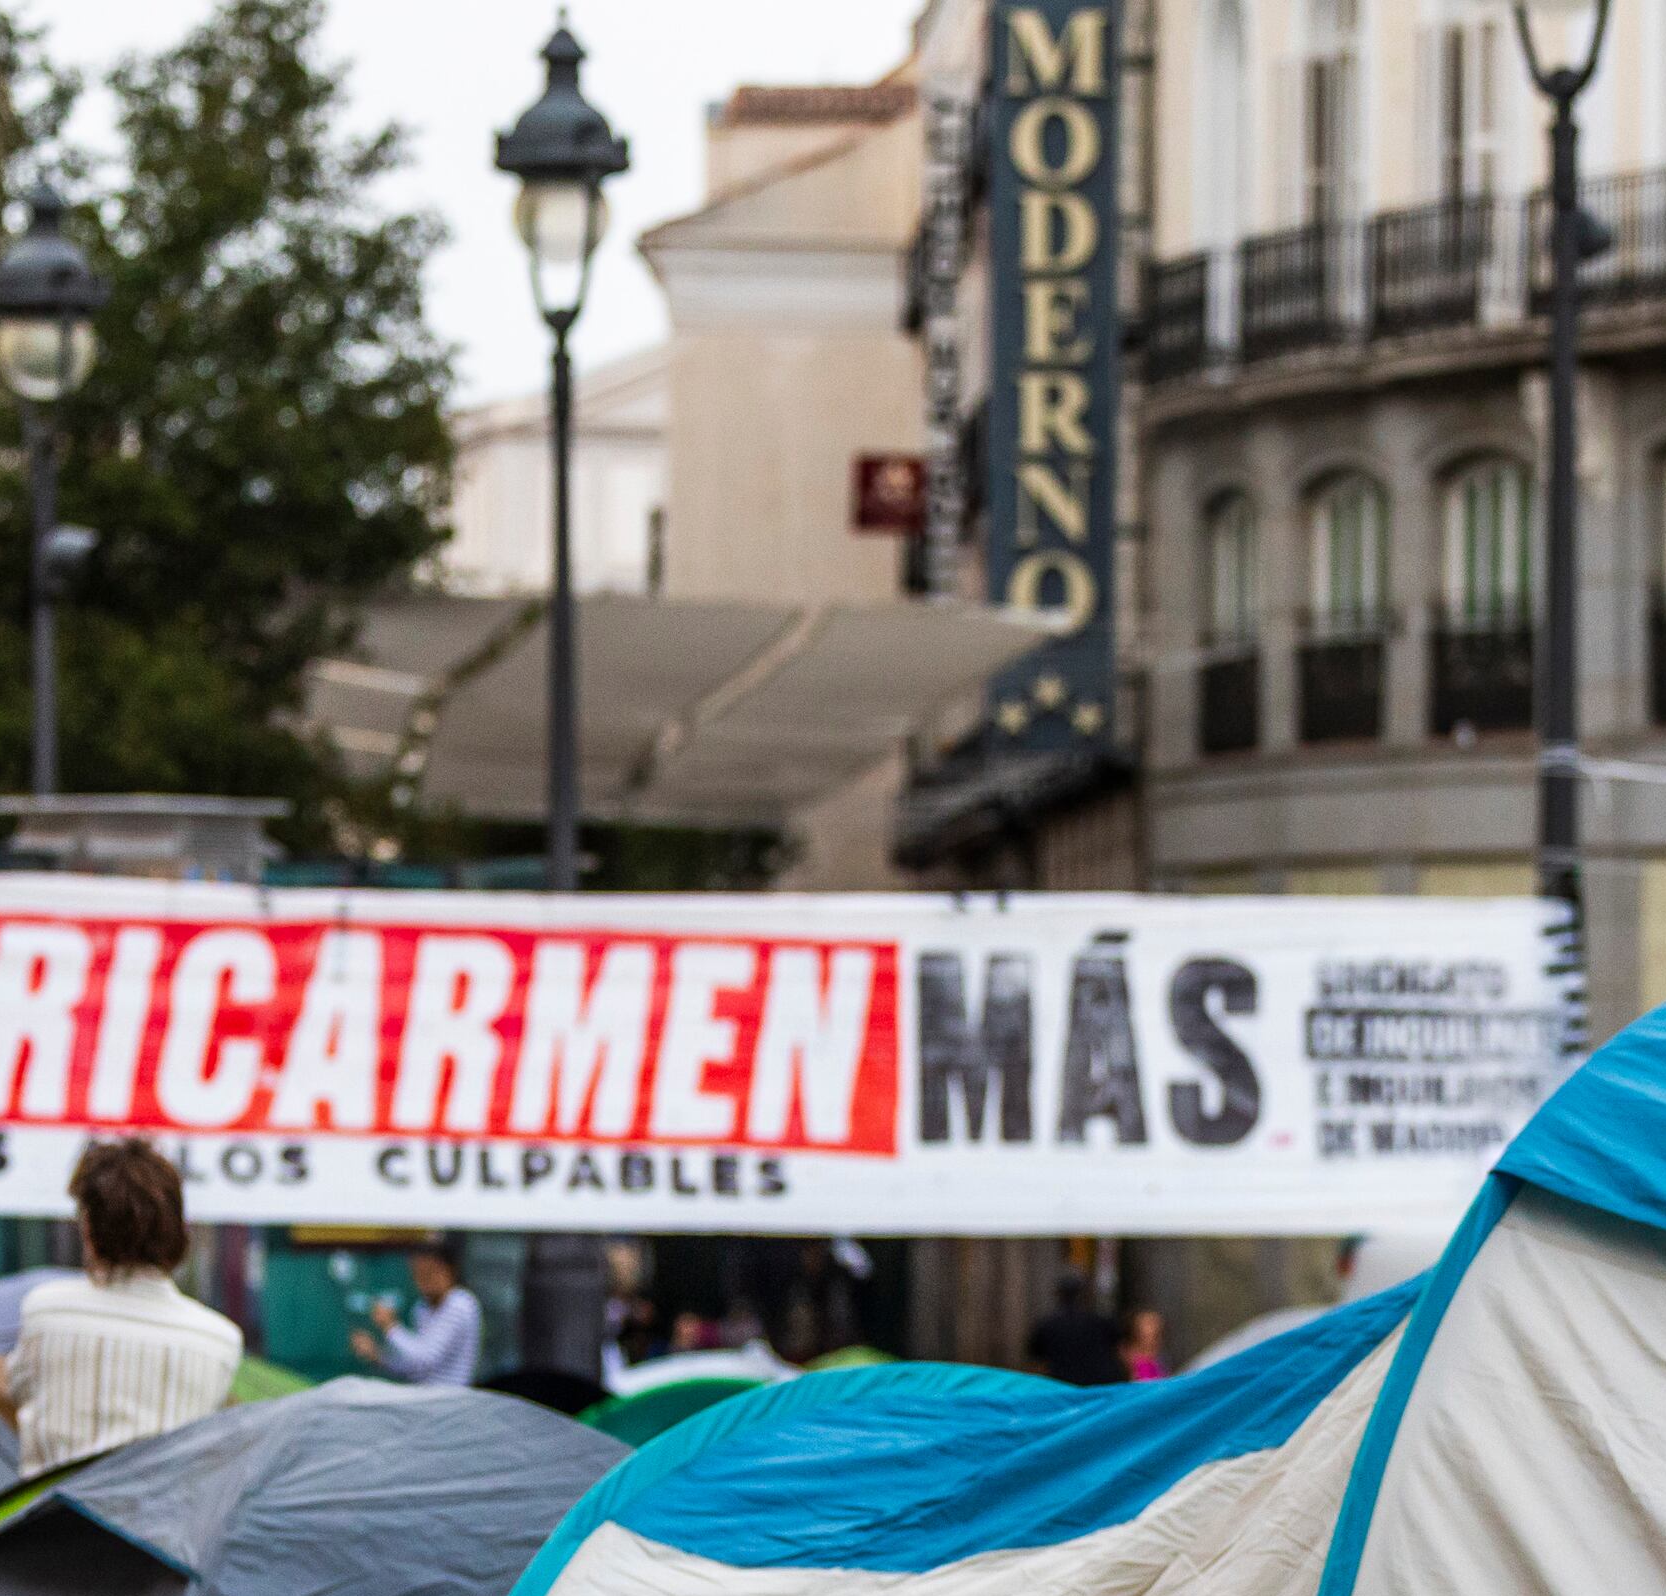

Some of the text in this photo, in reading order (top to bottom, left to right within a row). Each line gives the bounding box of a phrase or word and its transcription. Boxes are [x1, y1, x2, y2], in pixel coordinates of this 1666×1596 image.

[1006, 6, 1109, 634] MODERNO
[916, 929, 1262, 1147] MÁS
[177, 1140, 311, 1186] LOS
[375, 1144, 789, 1197] CULPABLES
